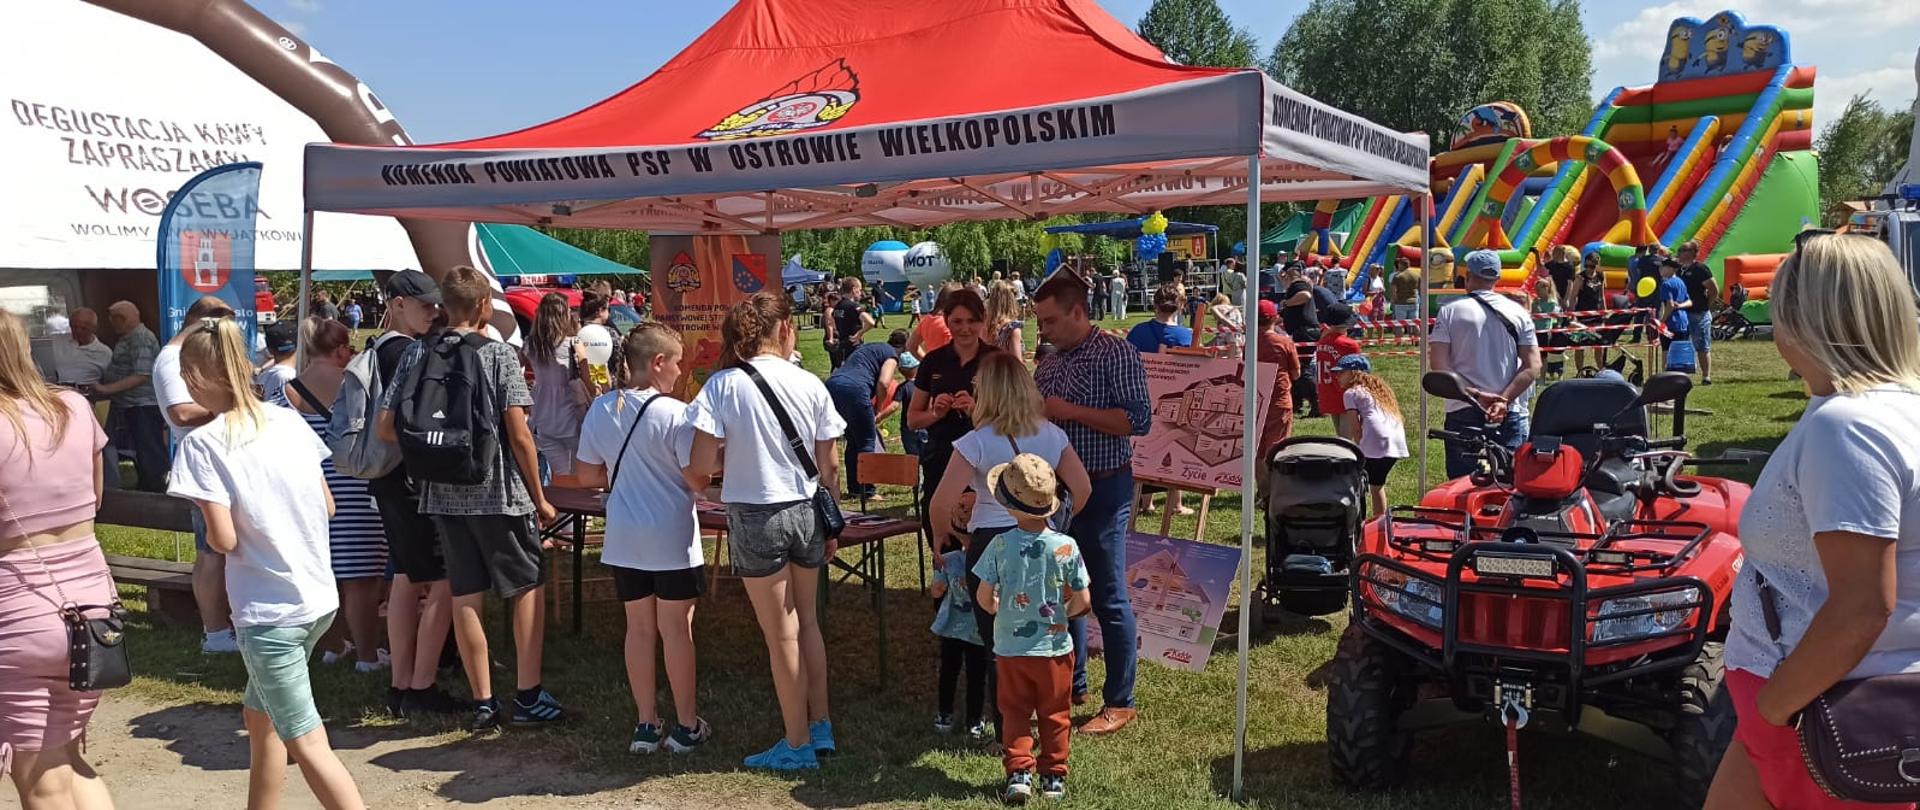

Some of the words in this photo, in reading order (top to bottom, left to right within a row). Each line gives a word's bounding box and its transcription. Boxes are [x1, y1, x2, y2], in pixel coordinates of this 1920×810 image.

[11, 98, 192, 143] DEGUSTACJA
[194, 122, 267, 146] KAWY
[381, 163, 476, 186] KOMENDA
[483, 153, 616, 184] POWIATOWA
[625, 150, 671, 177] PSP
[687, 146, 713, 173] W
[727, 132, 862, 170] OSTROWIE
[878, 103, 1116, 158] WIELKOPOLSKIM
[1272, 94, 1311, 135] KOMENDA
[1311, 107, 1352, 148] POWIATOWA
[1351, 122, 1365, 151] PSP
[71, 223, 150, 237] WOLIMY
[1317, 360, 1332, 384] 15
